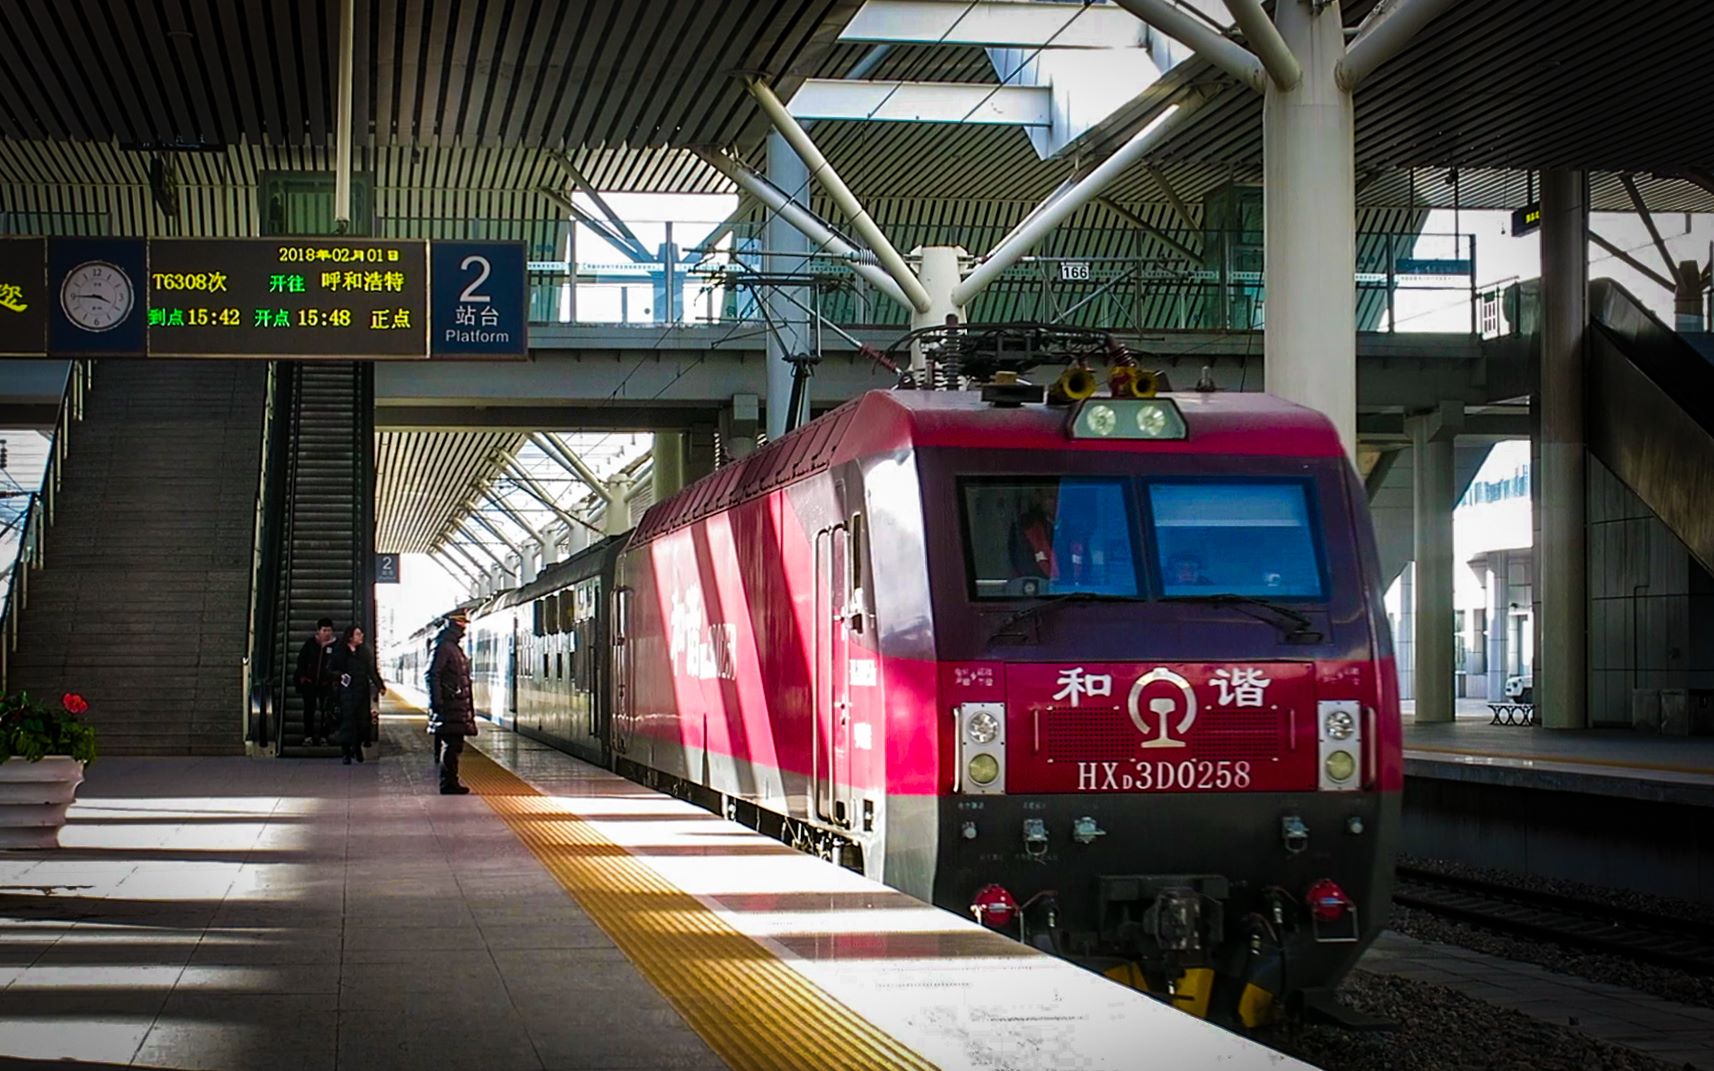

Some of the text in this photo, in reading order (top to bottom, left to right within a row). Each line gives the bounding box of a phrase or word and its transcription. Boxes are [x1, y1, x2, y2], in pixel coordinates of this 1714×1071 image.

[279, 247, 399, 263] 2018年02月01日
[92, 268, 102, 277] 12
[152, 270, 405, 293] T6308次 开往 呼和浩特
[459, 256, 491, 303] 2
[1064, 267, 1087, 279] 166
[148, 307, 411, 329] 到点 15:42 开点 15:48 正点
[455, 305, 500, 327] 站台
[445, 328, 510, 342] Platform
[382, 556, 392, 570] 2
[1052, 667, 1271, 707] 和 谐
[1077, 761, 1251, 790] HXD3D0258
